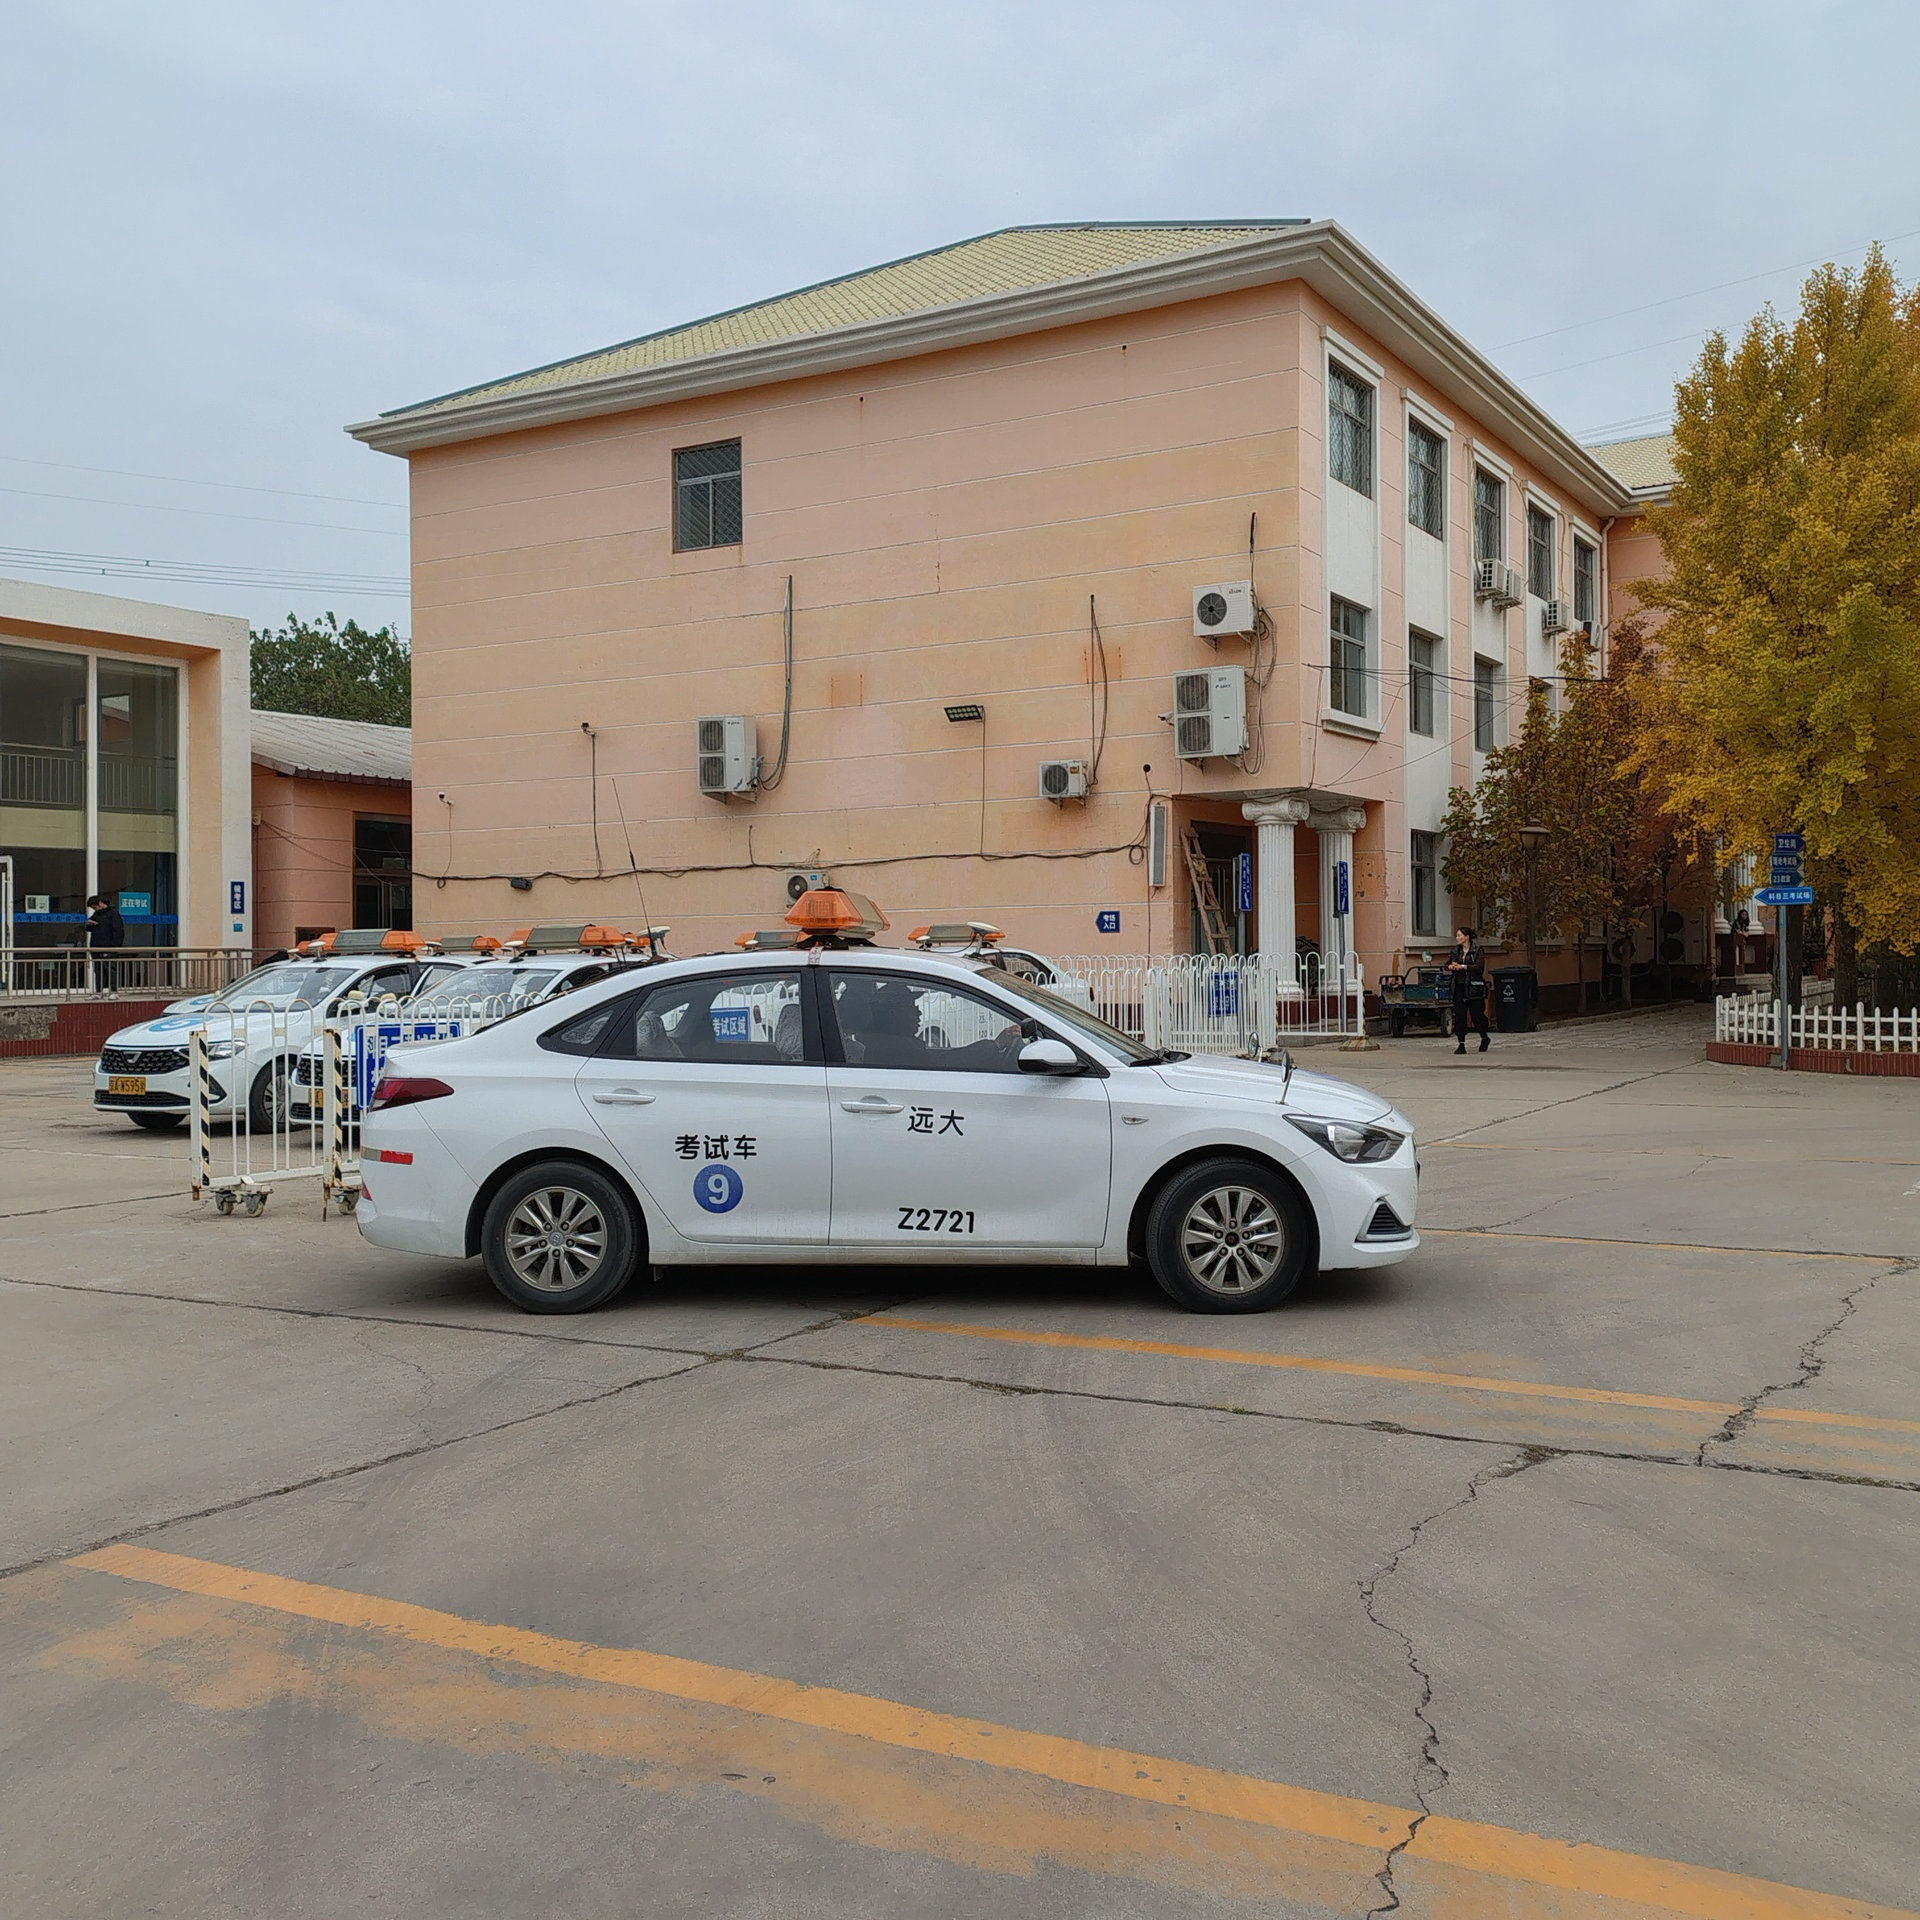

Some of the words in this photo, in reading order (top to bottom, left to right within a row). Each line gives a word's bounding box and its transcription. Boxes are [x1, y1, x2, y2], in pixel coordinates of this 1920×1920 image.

[1778, 838, 1797, 849] 卫生间
[121, 898, 148, 908] 正在考试
[1769, 891, 1810, 900] 科目三考试场
[1103, 922, 1116, 930] 入口
[712, 1016, 746, 1037] 考试区域
[907, 1106, 965, 1136] 远大
[675, 1134, 758, 1160] 考试车
[707, 1173, 730, 1205] 9
[898, 1207, 975, 1233] Z2721
